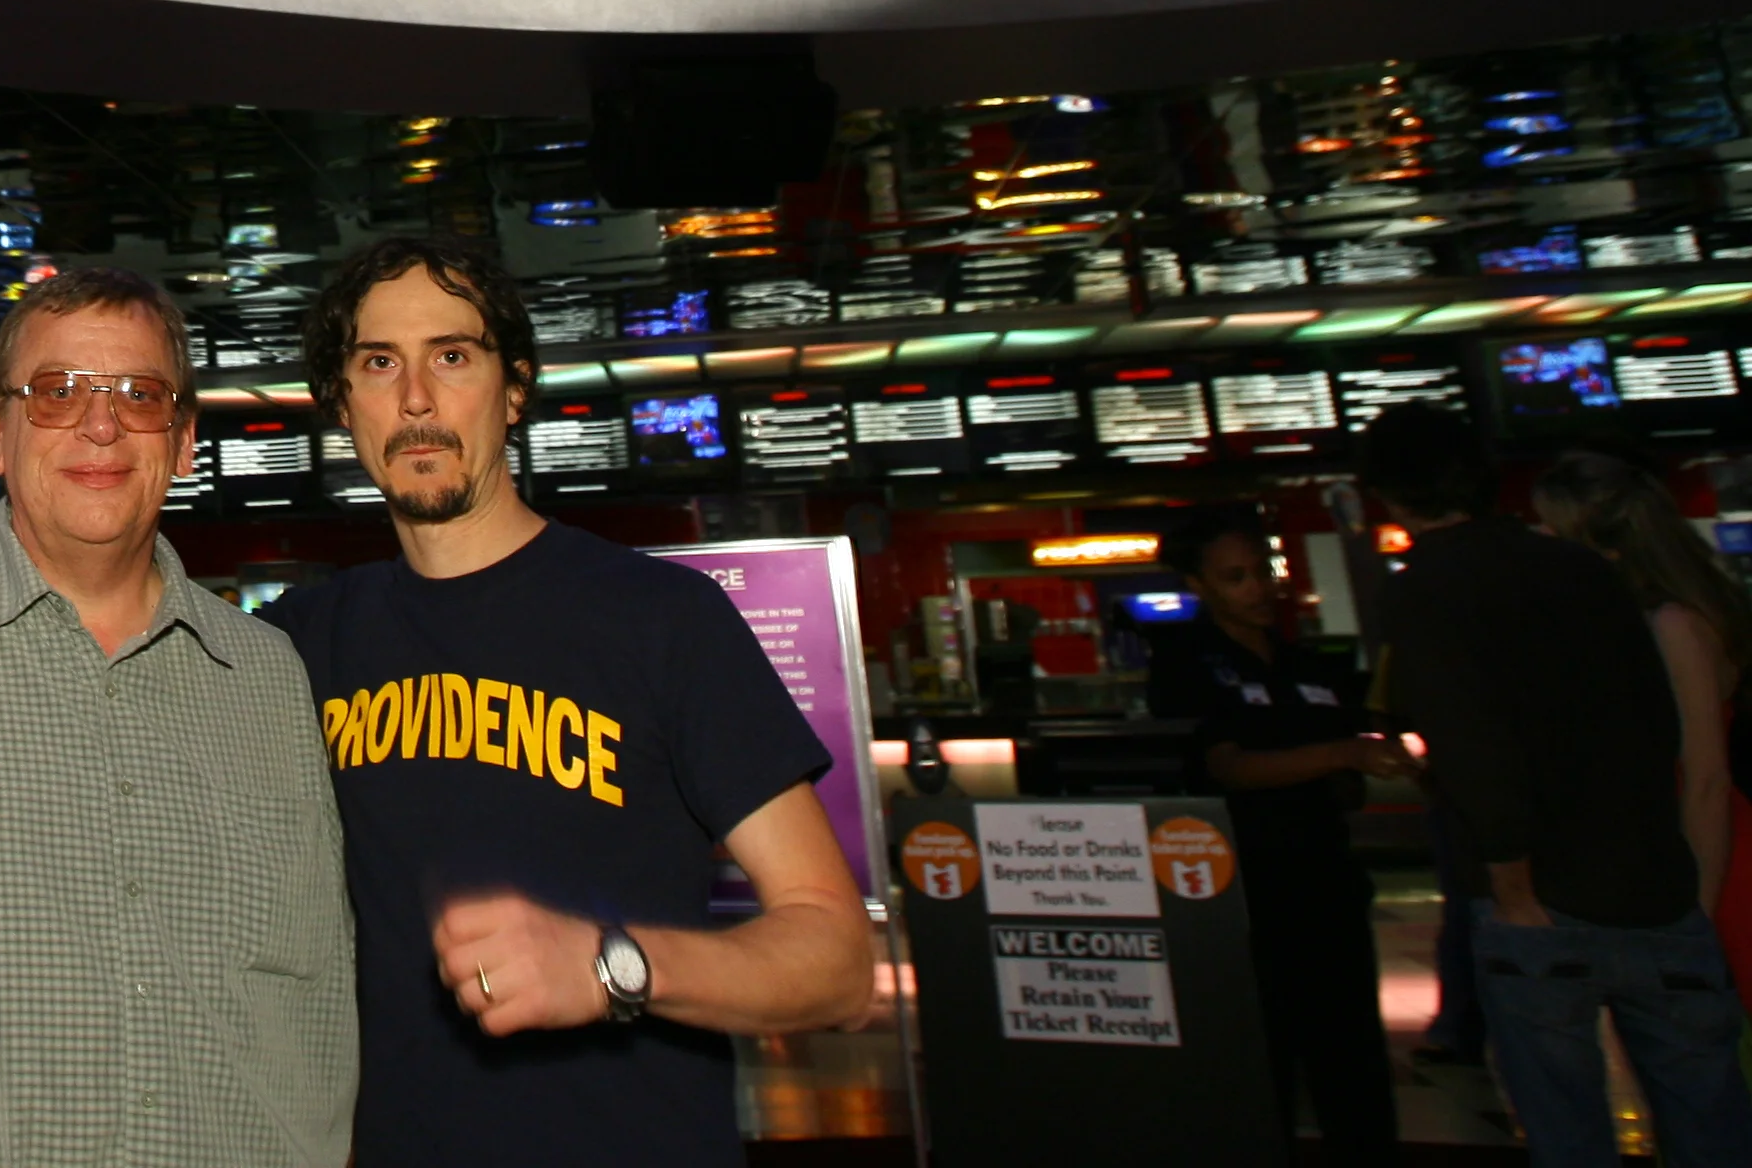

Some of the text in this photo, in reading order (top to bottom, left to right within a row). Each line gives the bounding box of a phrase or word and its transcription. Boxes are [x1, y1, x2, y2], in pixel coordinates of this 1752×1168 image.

[323, 672, 624, 808] PROVIDENCE
[987, 841, 1142, 858] No Food or Drinks
[994, 864, 1056, 884] Beyond
[1061, 864, 1091, 881] this
[1032, 891, 1075, 906] Thank
[997, 930, 1163, 959] WELCOME
[1047, 962, 1118, 983] Please
[1020, 986, 1154, 1010] Retain Your
[1009, 1011, 1174, 1041] Ticket Receipt
